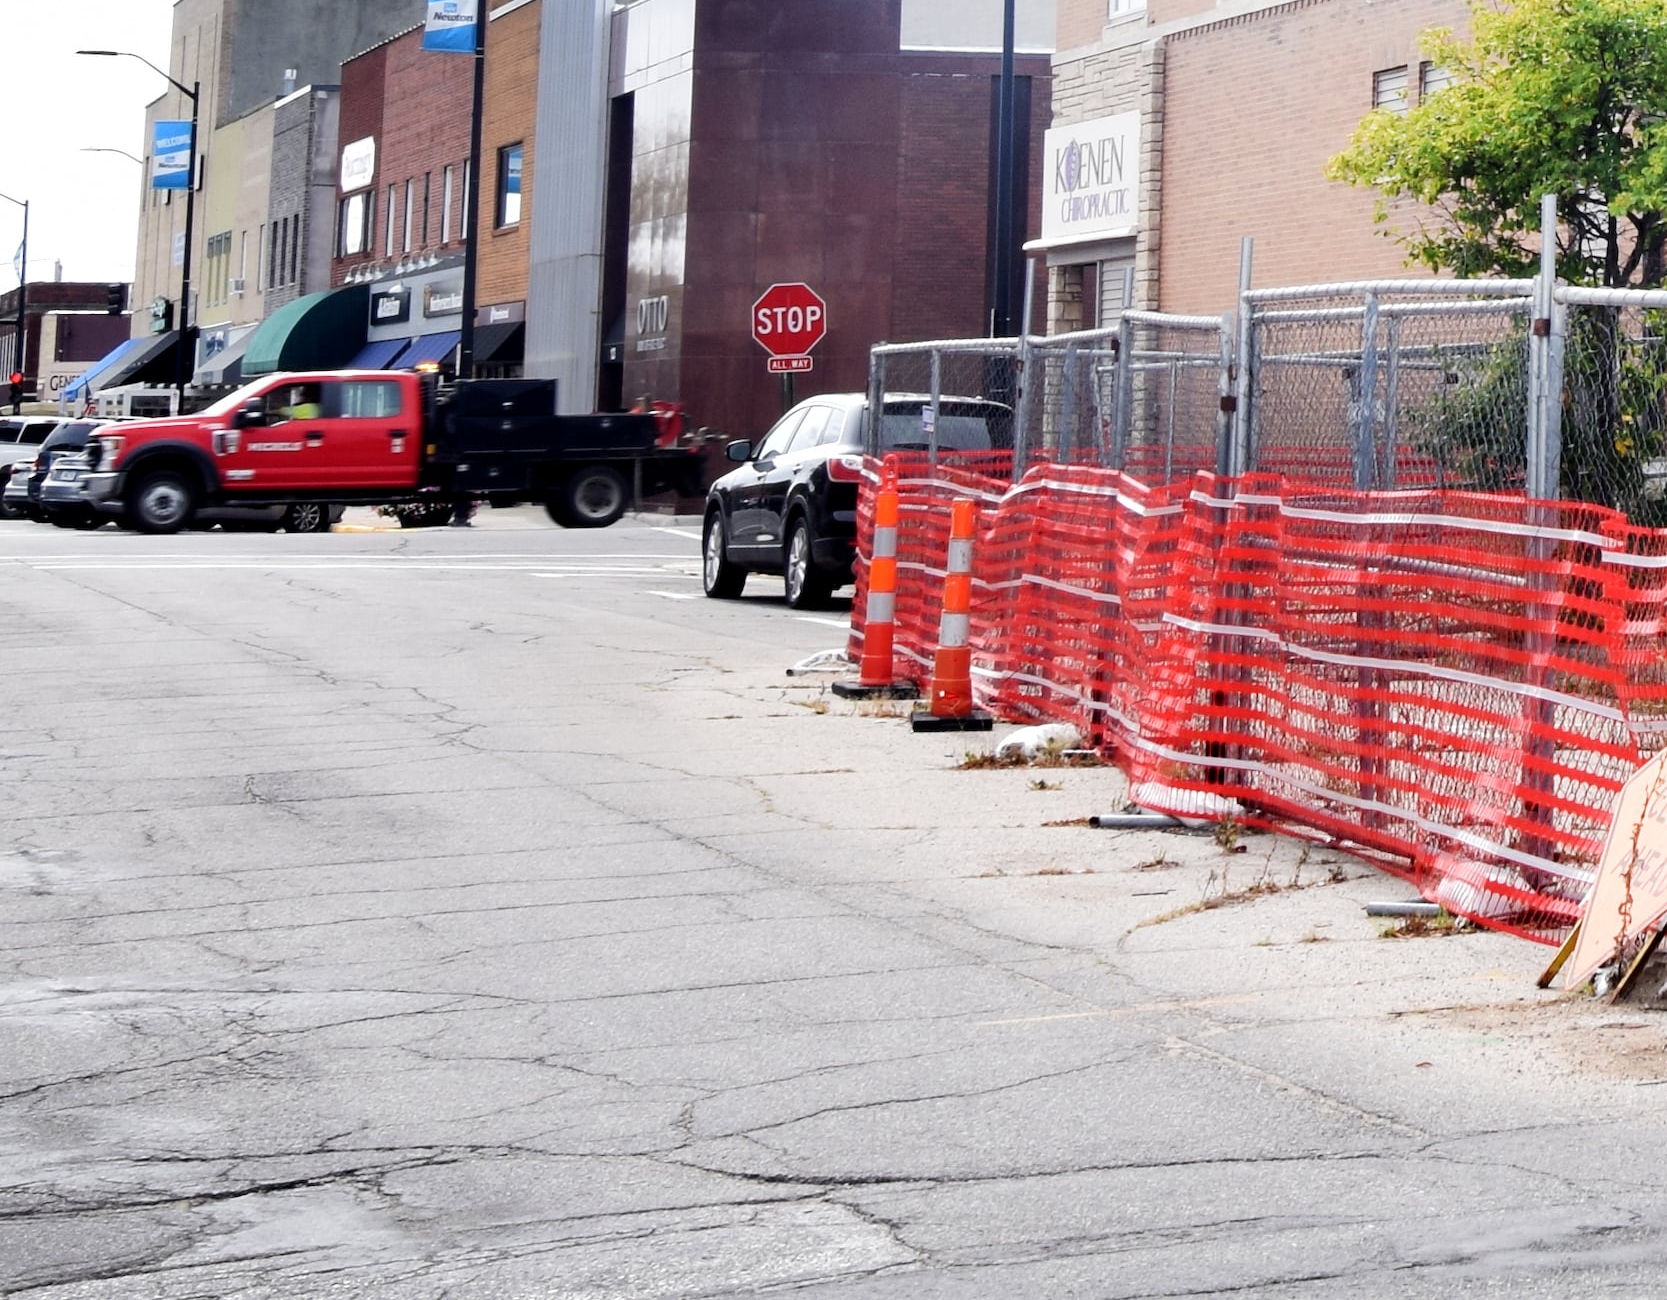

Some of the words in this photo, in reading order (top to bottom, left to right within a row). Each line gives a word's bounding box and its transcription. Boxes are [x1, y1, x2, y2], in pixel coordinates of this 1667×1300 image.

[433, 12, 473, 22] Newton
[1061, 188, 1130, 224] CHIROPRACTIC
[637, 295, 668, 334] OTTO
[757, 306, 821, 335] STOP
[771, 361, 787, 370] ALL
[791, 359, 809, 369] WAY
